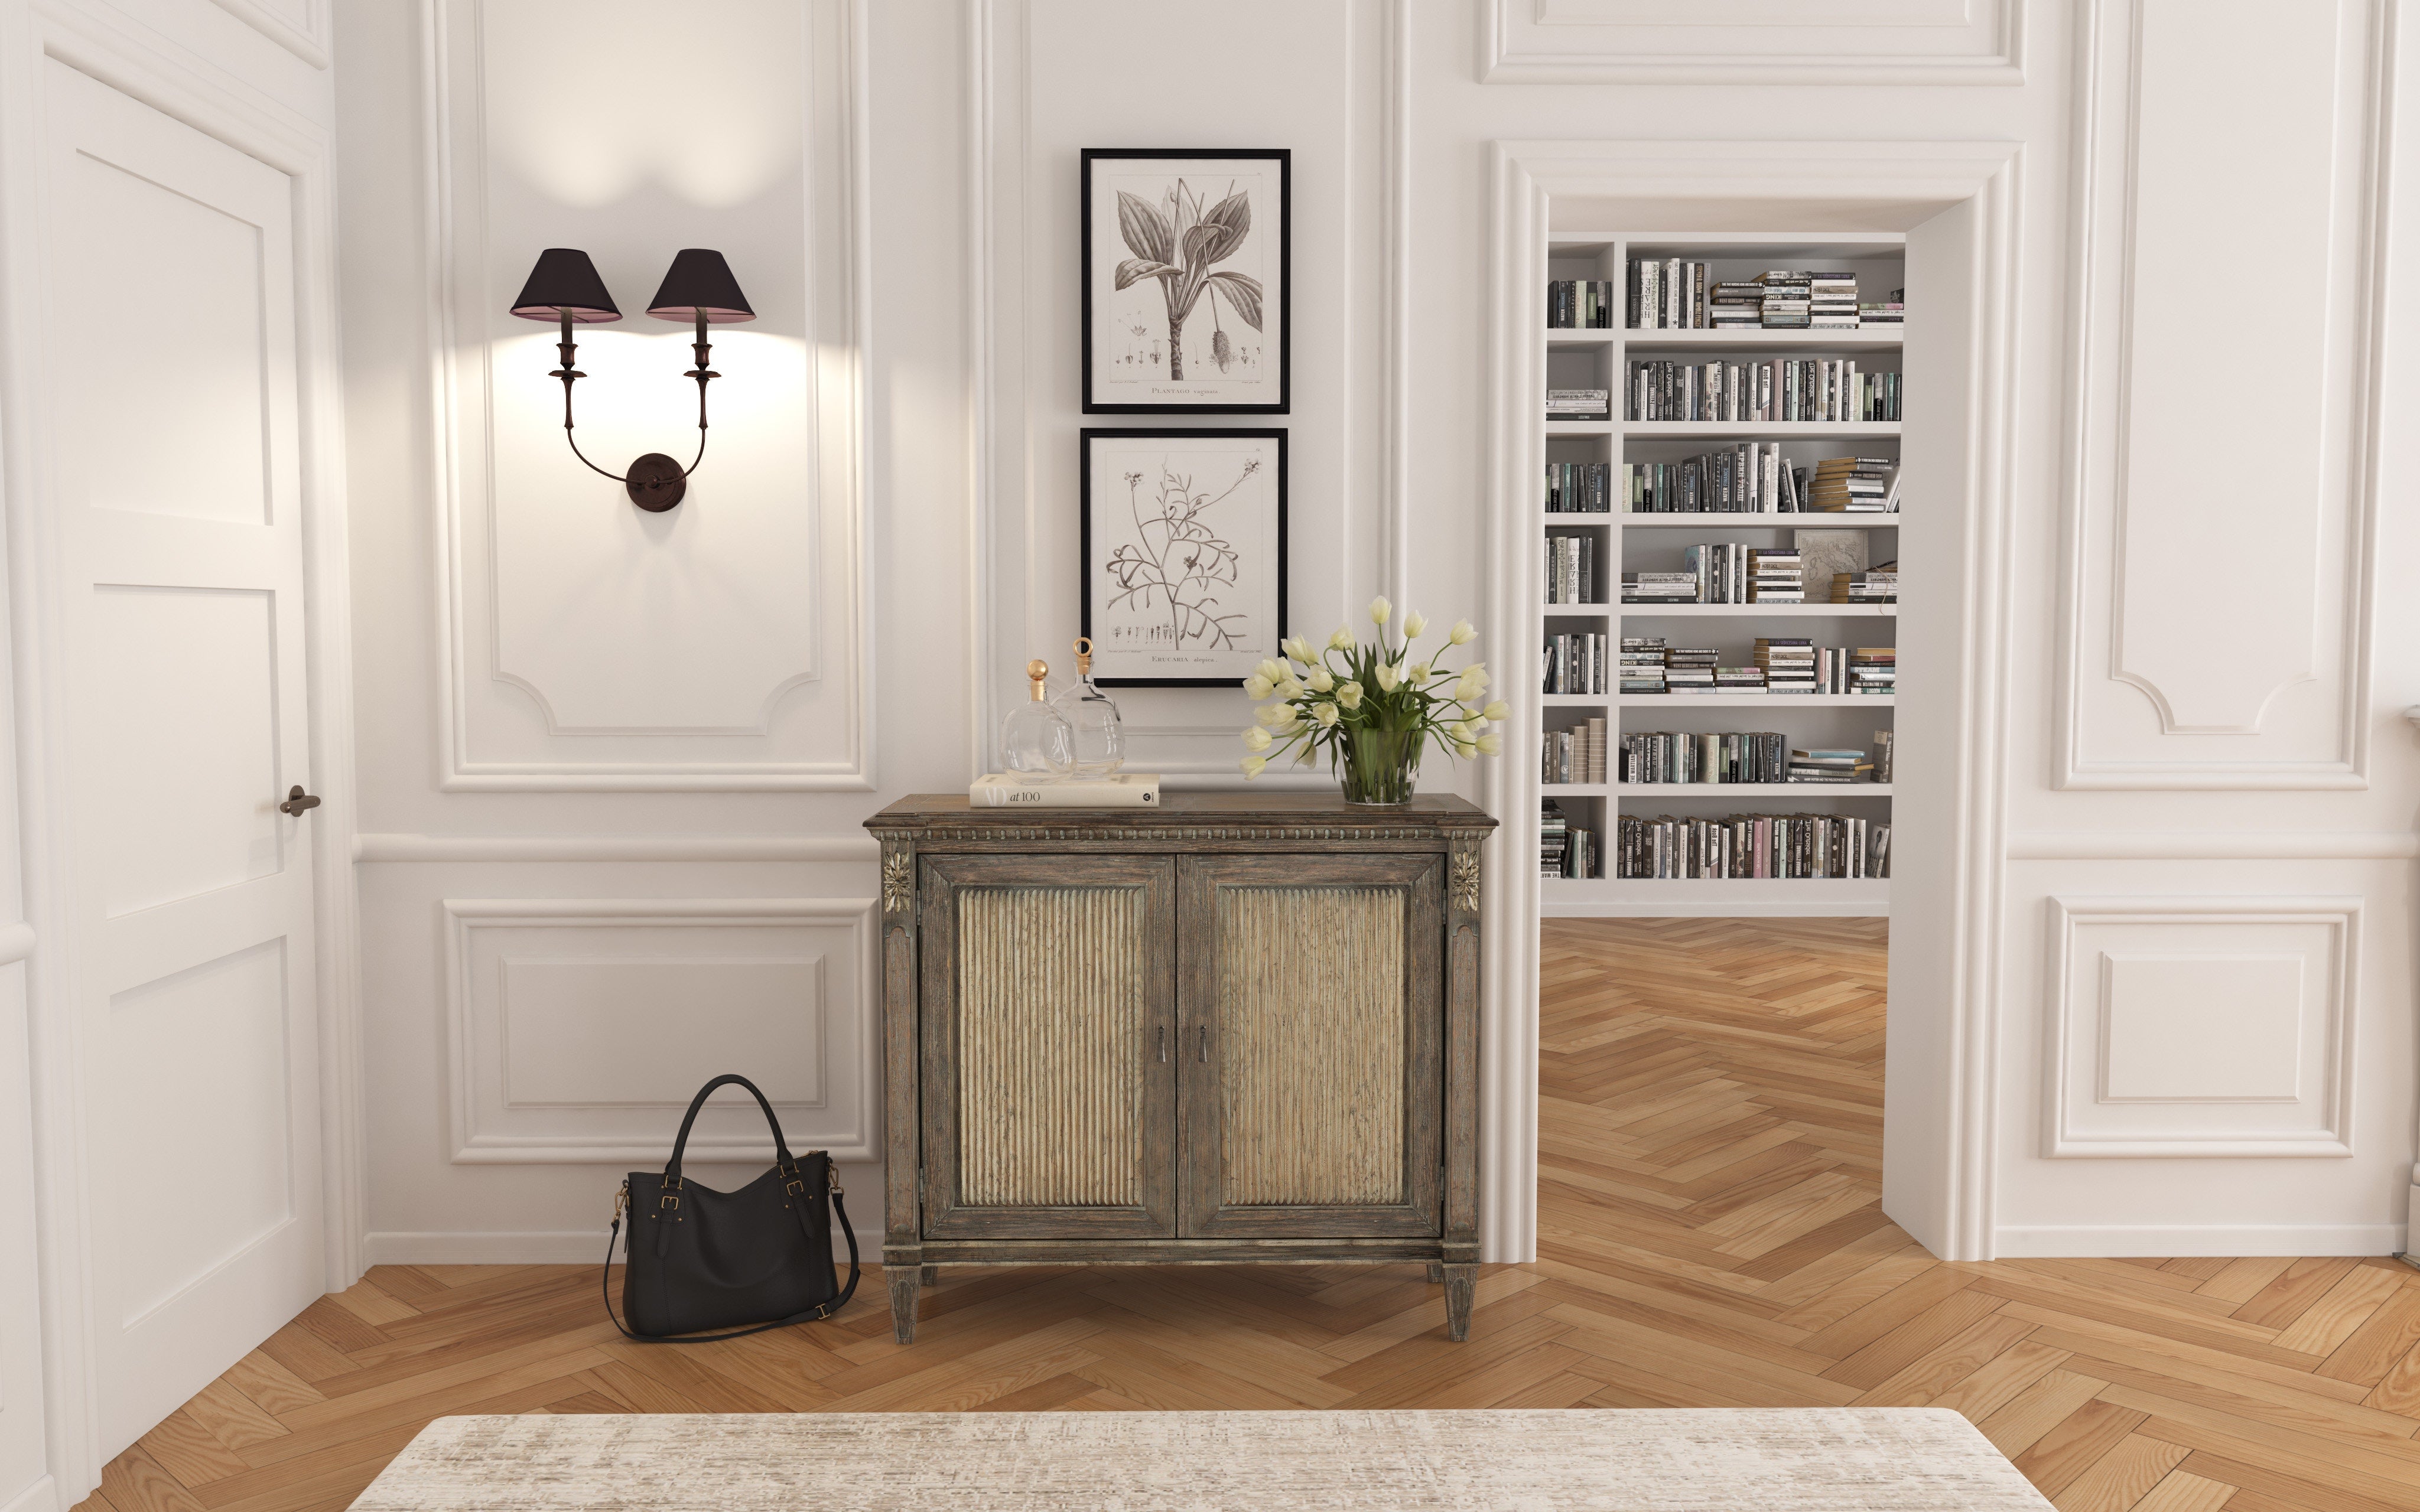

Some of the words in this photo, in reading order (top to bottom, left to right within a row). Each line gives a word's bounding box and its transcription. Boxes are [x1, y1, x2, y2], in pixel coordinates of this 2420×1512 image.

[981, 787, 1007, 807] AD
[1010, 793, 1019, 801] at
[1022, 792, 1040, 801] 100
